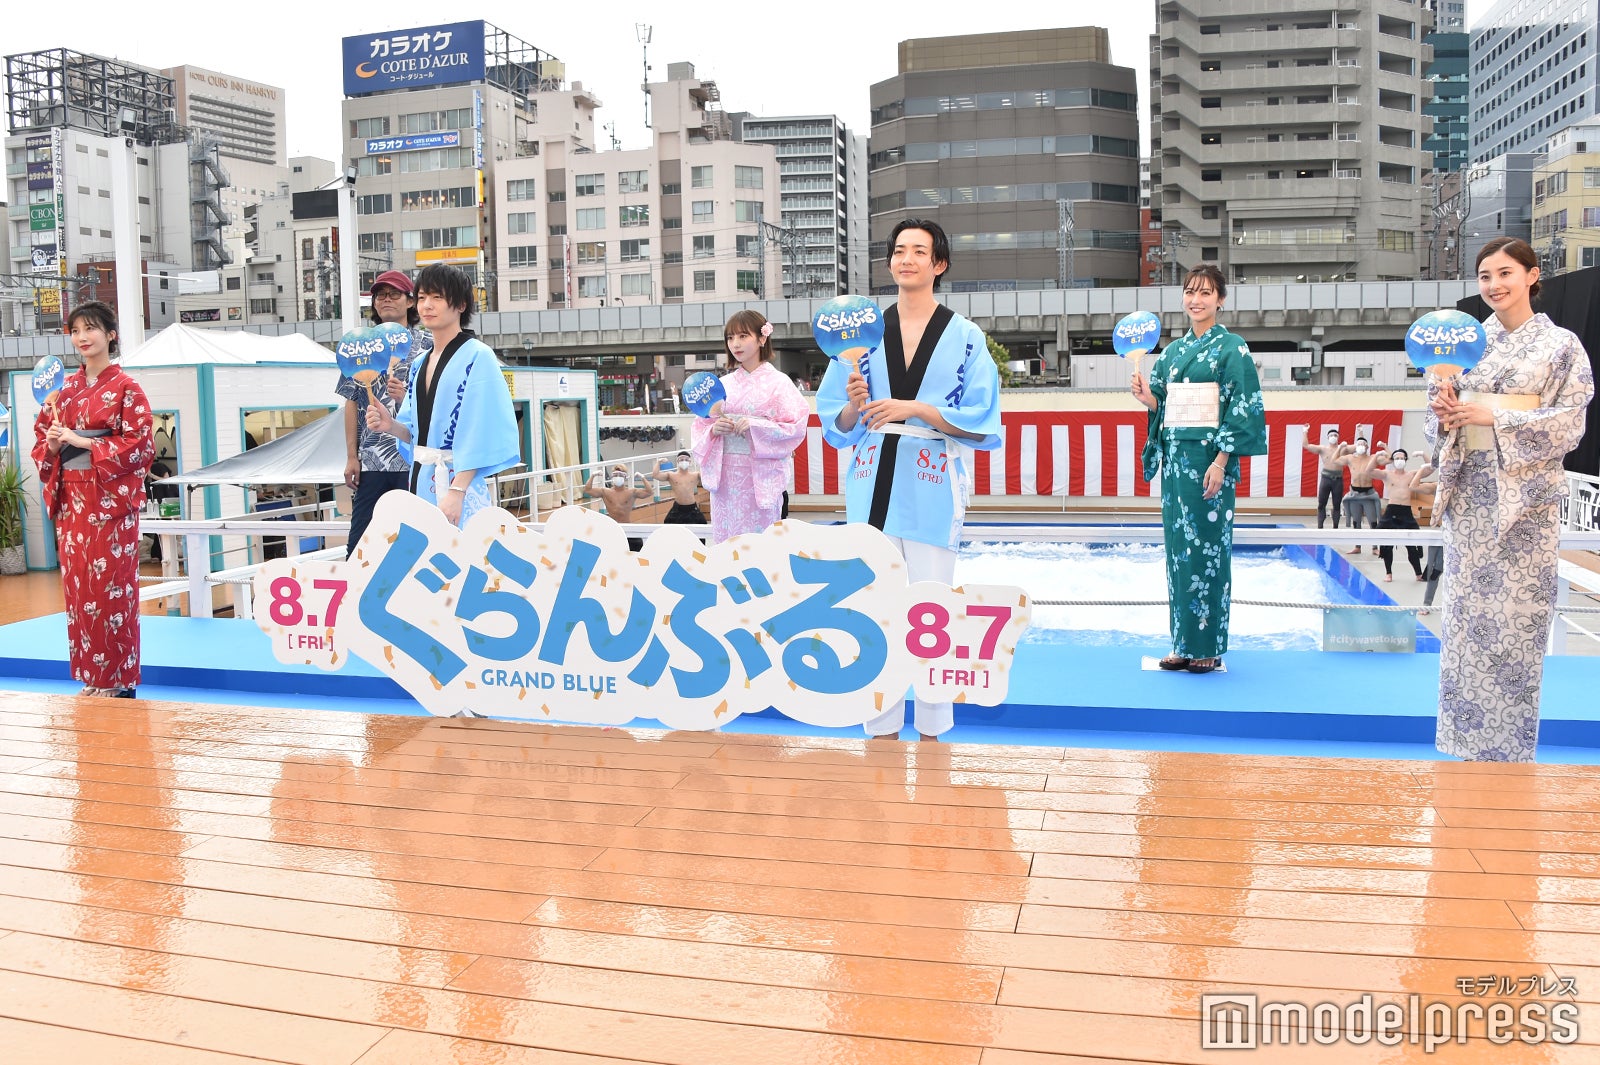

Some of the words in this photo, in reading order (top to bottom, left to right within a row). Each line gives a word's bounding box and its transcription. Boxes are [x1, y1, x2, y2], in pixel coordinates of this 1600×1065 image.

[370, 31, 453, 58] カラオケ
[381, 58, 417, 74] COTE
[390, 71, 435, 82] コート・ダジュール
[189, 71, 206, 82] HOTEL
[207, 75, 228, 89] OURS
[230, 80, 244, 92] INN
[245, 84, 276, 101] HANKYU
[369, 140, 404, 151] カラオケ
[981, 283, 1014, 292] SAPIX
[816, 307, 877, 332] ぐらんぶる
[1116, 319, 1157, 338] ぐらんぶる
[841, 329, 856, 340] 8.7
[1410, 324, 1478, 345] ぐらんぶる
[338, 338, 385, 358] ぐらんぶる
[1434, 345, 1451, 355] 8.7
[684, 376, 715, 404] ぐらんぶる
[917, 448, 947, 473] 8.7
[269, 576, 348, 627] 8.7
[358, 521, 888, 699] ぐらんぶる
[905, 601, 1012, 660] 8.7
[1329, 633, 1410, 647] #citywavetokyo
[481, 669, 555, 690] GRAND
[563, 673, 617, 694] BLUE
